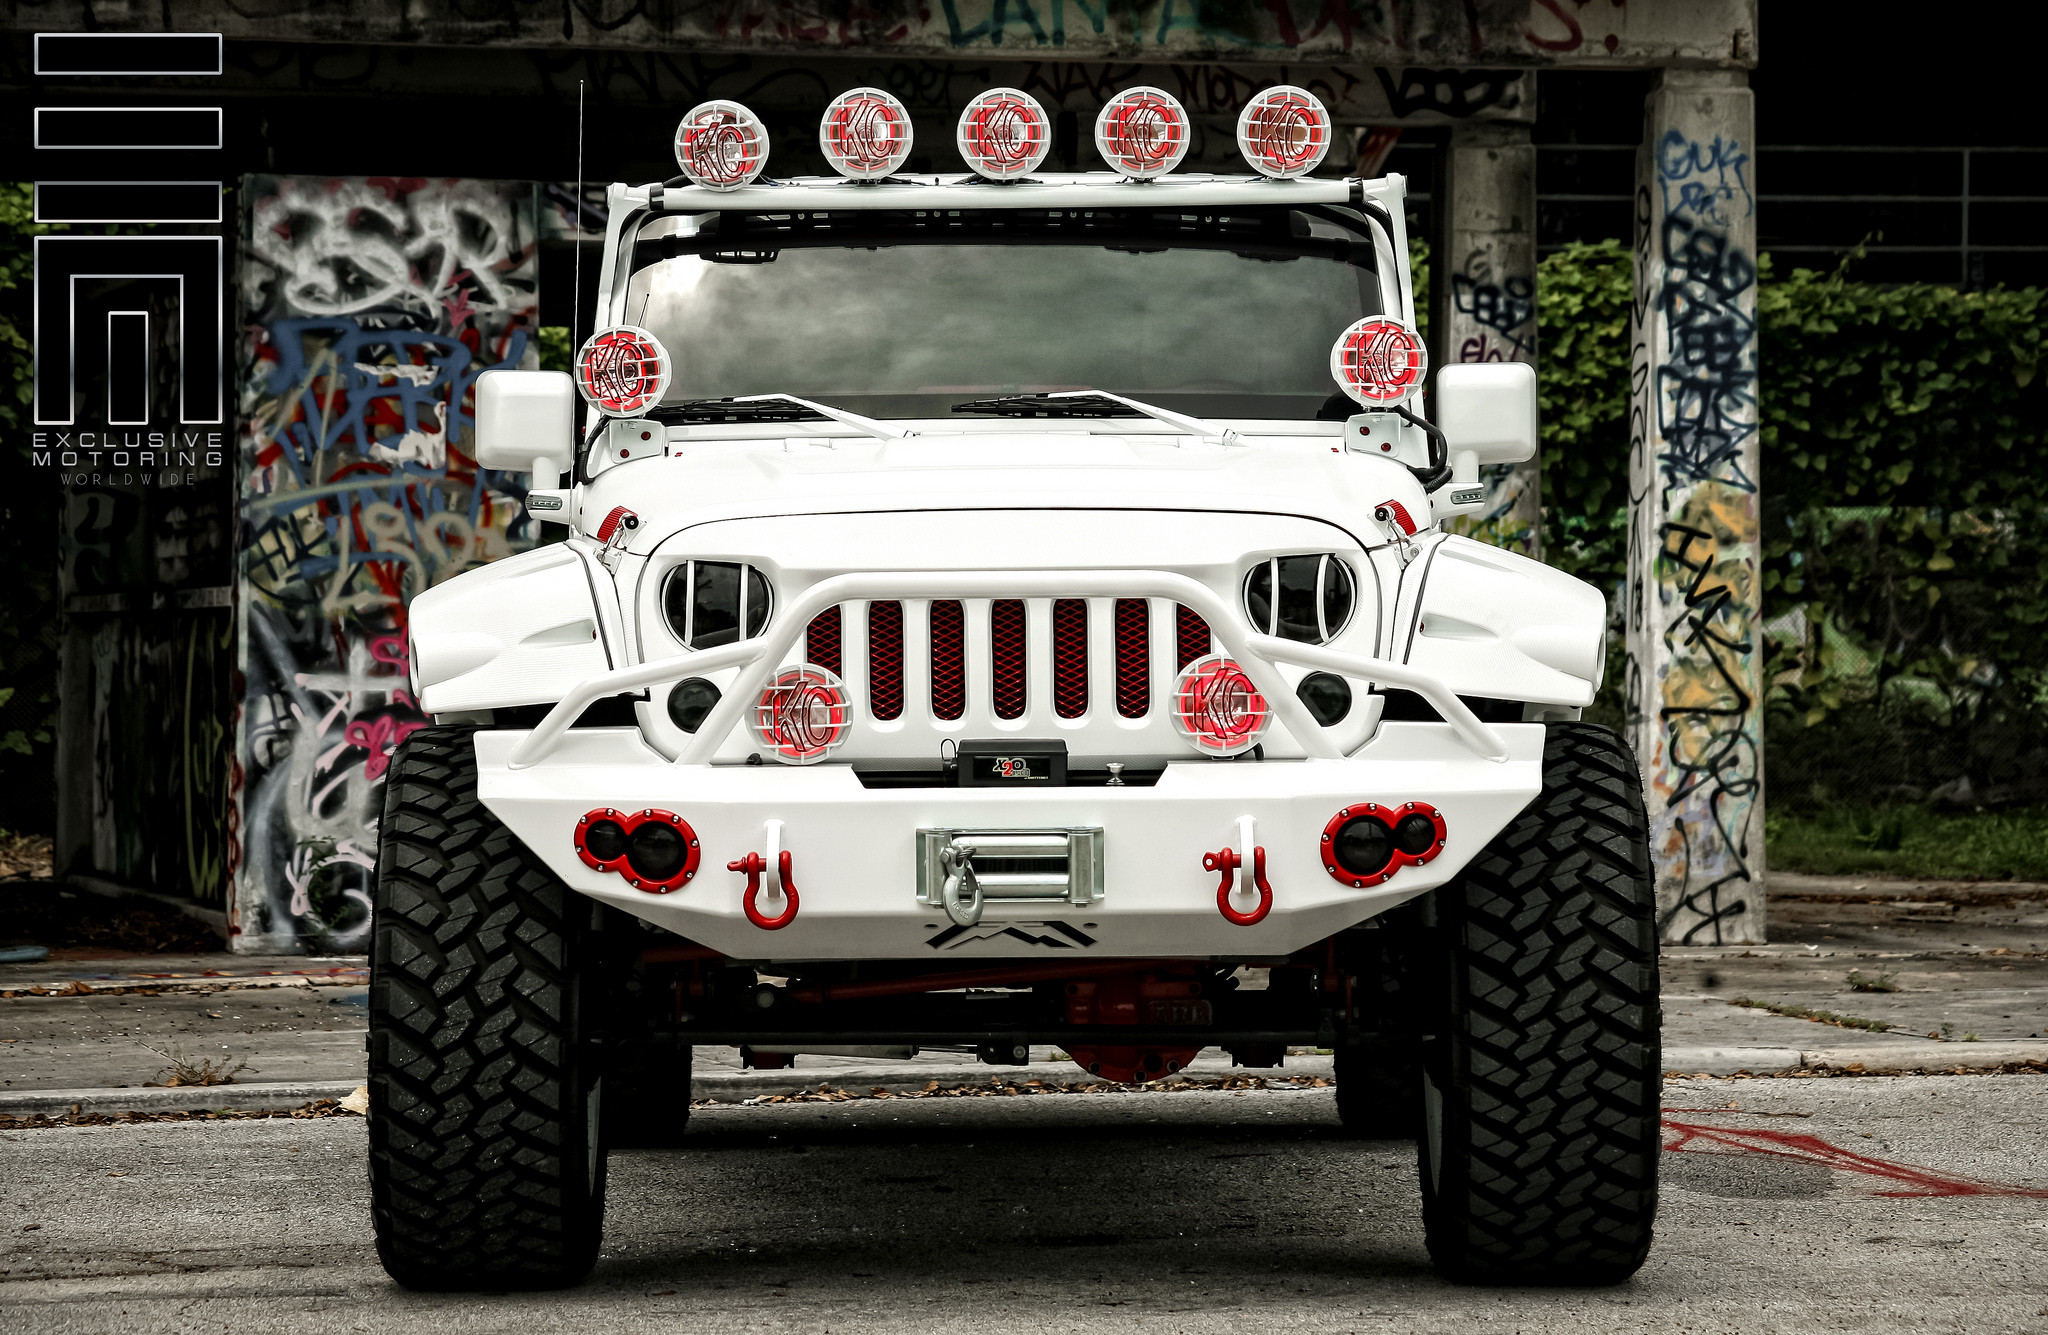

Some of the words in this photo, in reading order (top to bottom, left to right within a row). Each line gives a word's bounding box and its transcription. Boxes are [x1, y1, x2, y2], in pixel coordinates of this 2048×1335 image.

[690, 122, 746, 182] KC
[839, 100, 894, 162] KC
[977, 100, 1032, 163] KC
[1117, 100, 1172, 163] KC
[1259, 101, 1314, 164] KC
[589, 338, 645, 403] KC
[1355, 326, 1412, 390] KC
[771, 680, 835, 752] KC
[1192, 668, 1256, 740] KC
